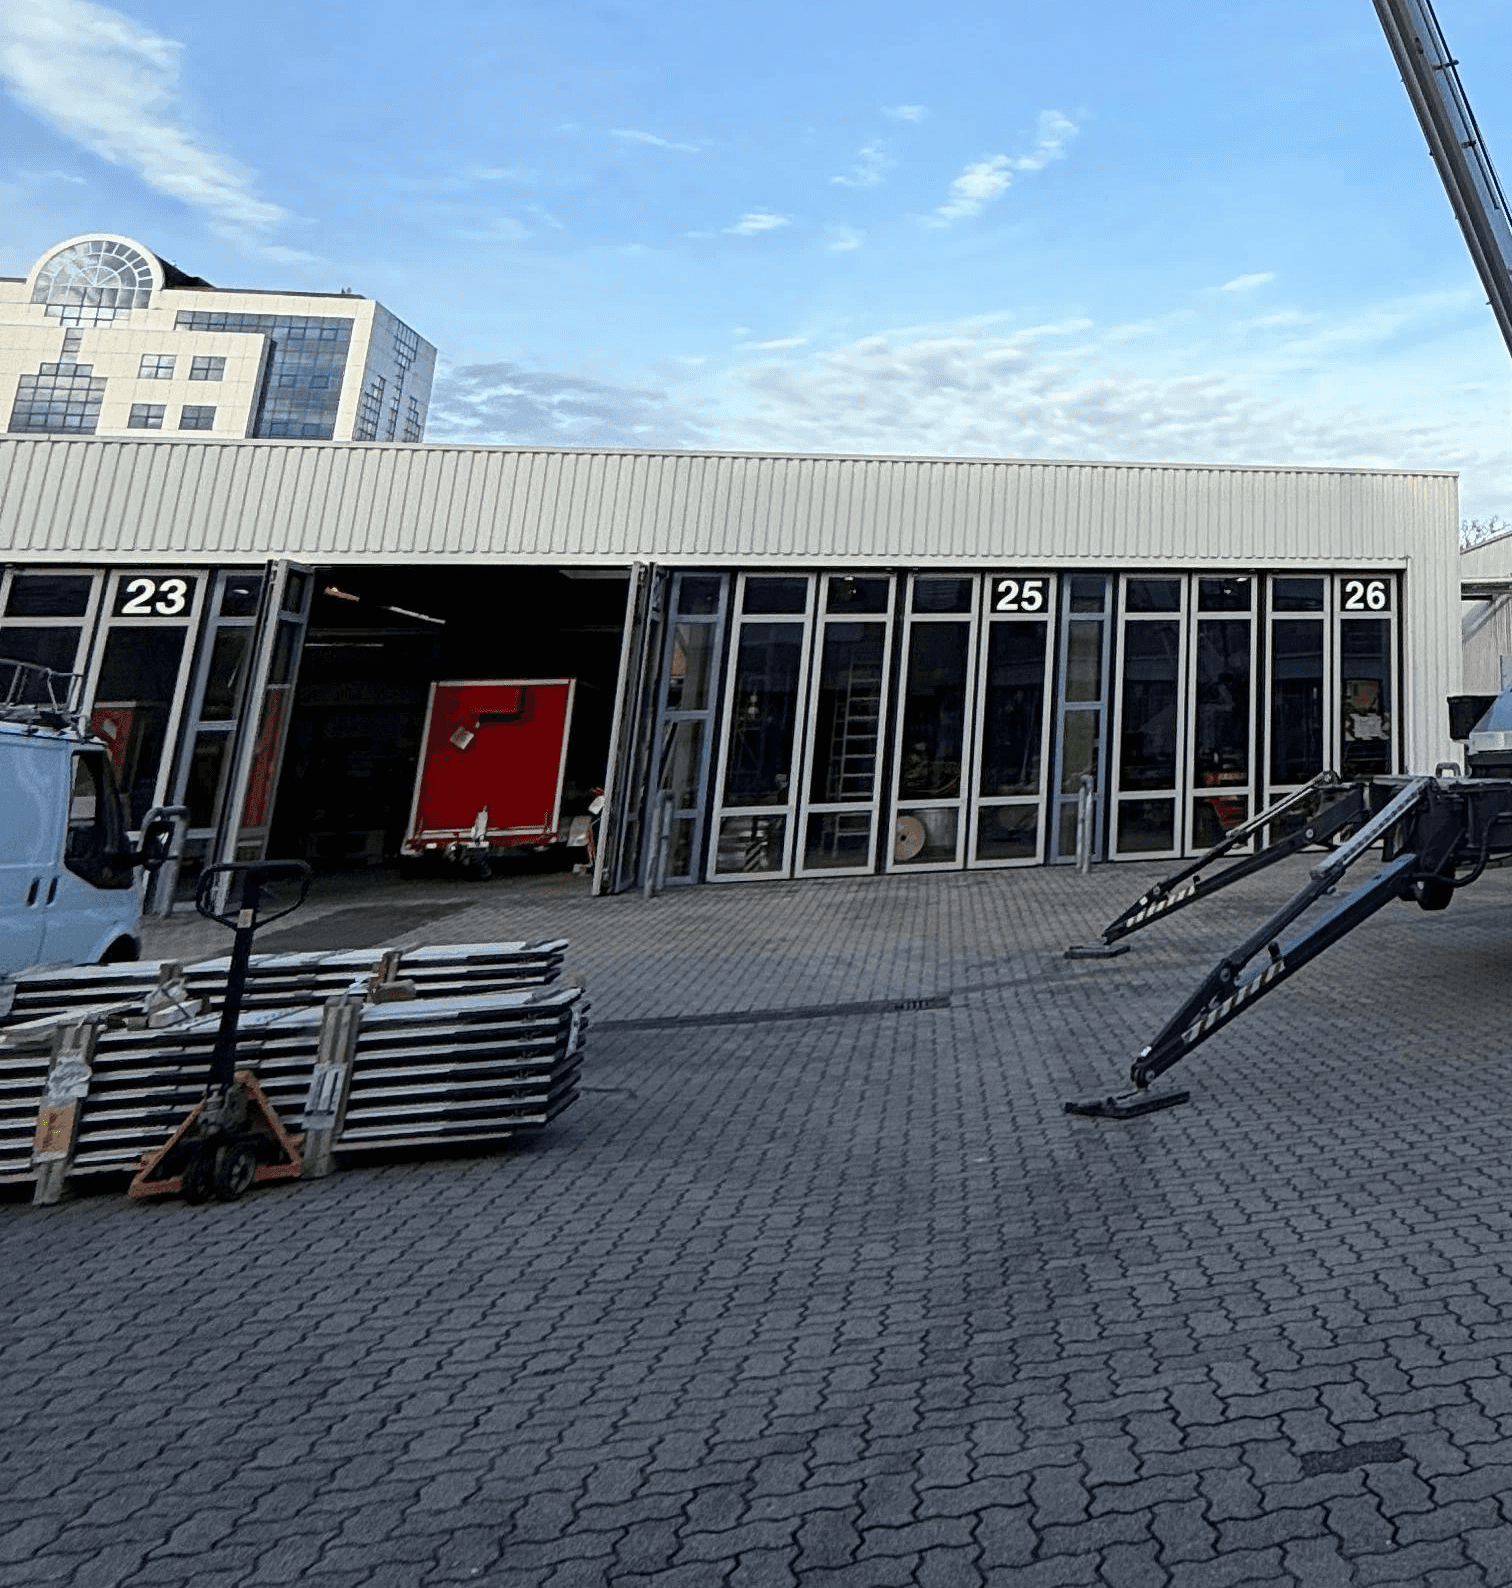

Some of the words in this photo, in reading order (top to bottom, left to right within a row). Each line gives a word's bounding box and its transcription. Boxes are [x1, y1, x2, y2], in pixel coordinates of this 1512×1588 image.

[121, 578, 187, 614] 23
[996, 580, 1042, 611] 25
[1345, 580, 1386, 609] 26
